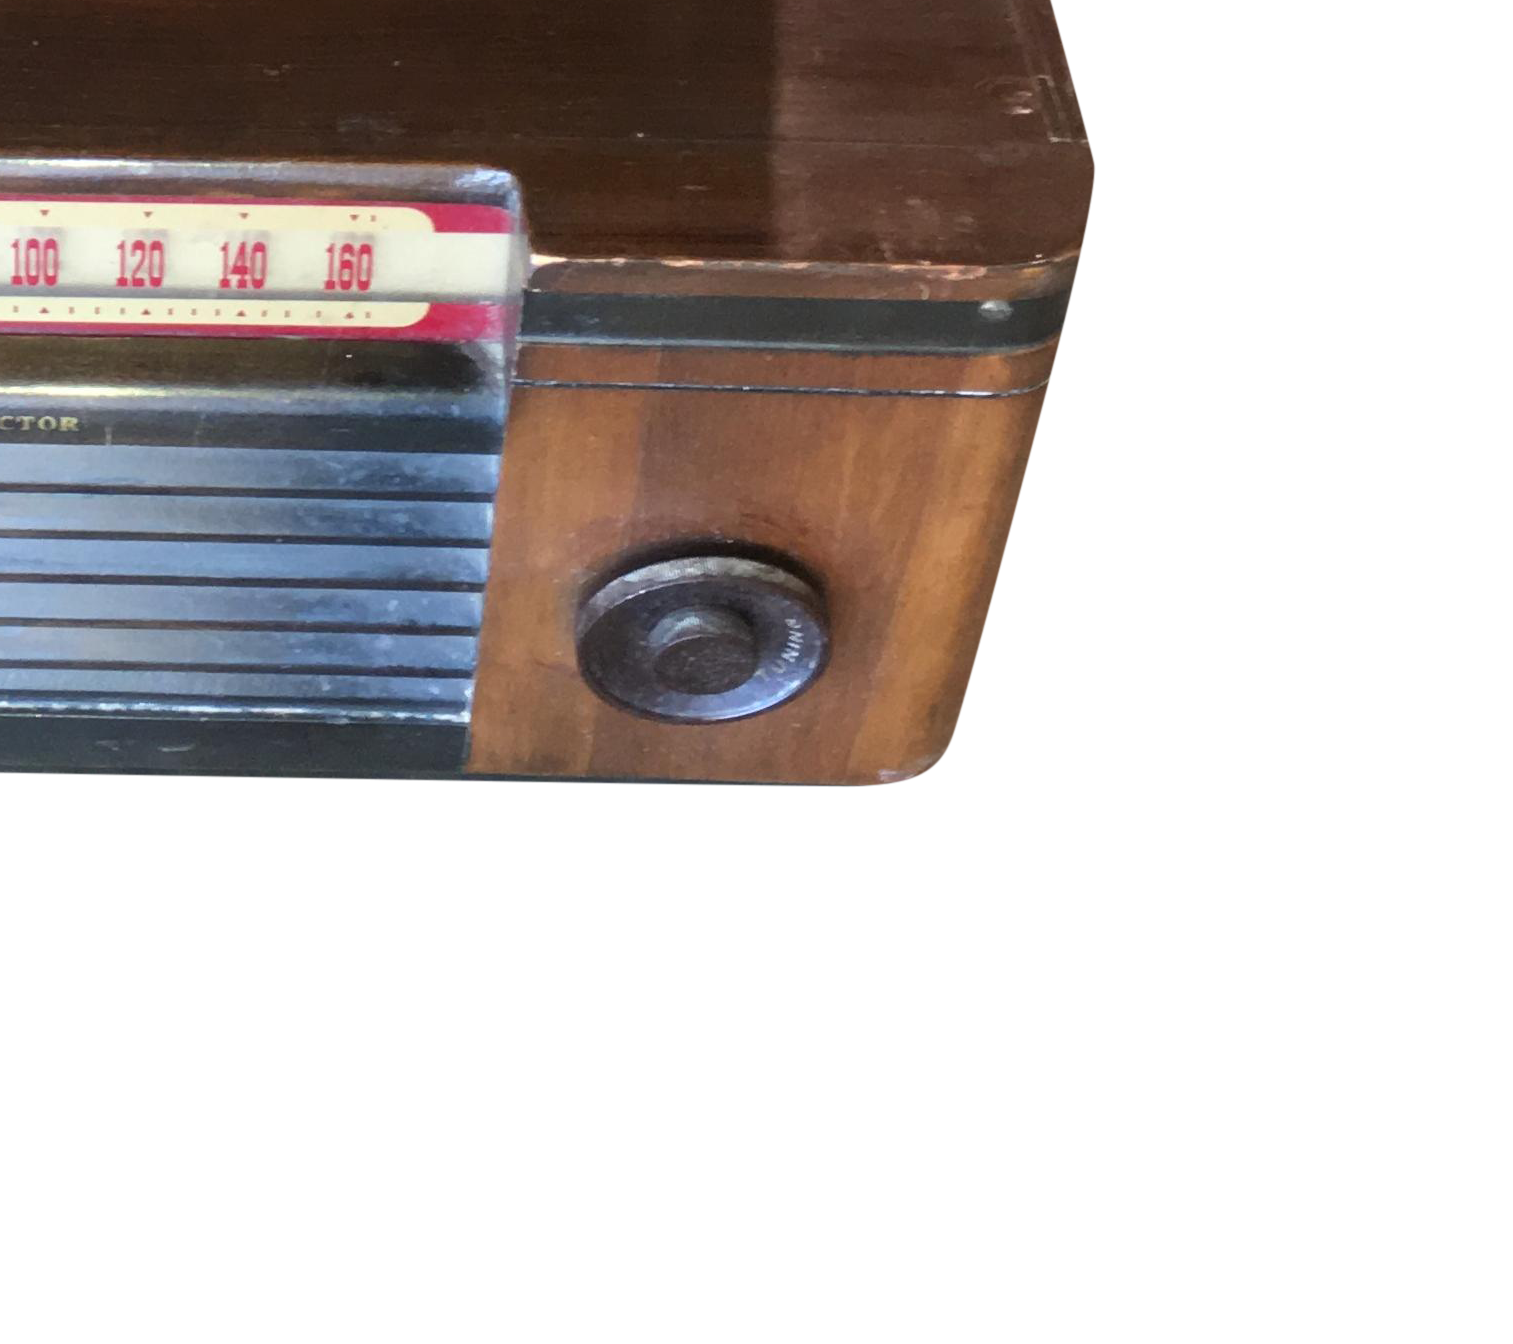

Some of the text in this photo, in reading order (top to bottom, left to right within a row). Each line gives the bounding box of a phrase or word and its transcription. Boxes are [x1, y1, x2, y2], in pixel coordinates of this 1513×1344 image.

[10, 238, 59, 287] 100
[116, 240, 164, 288] 120
[219, 241, 267, 290] 140
[324, 243, 373, 291] 160
